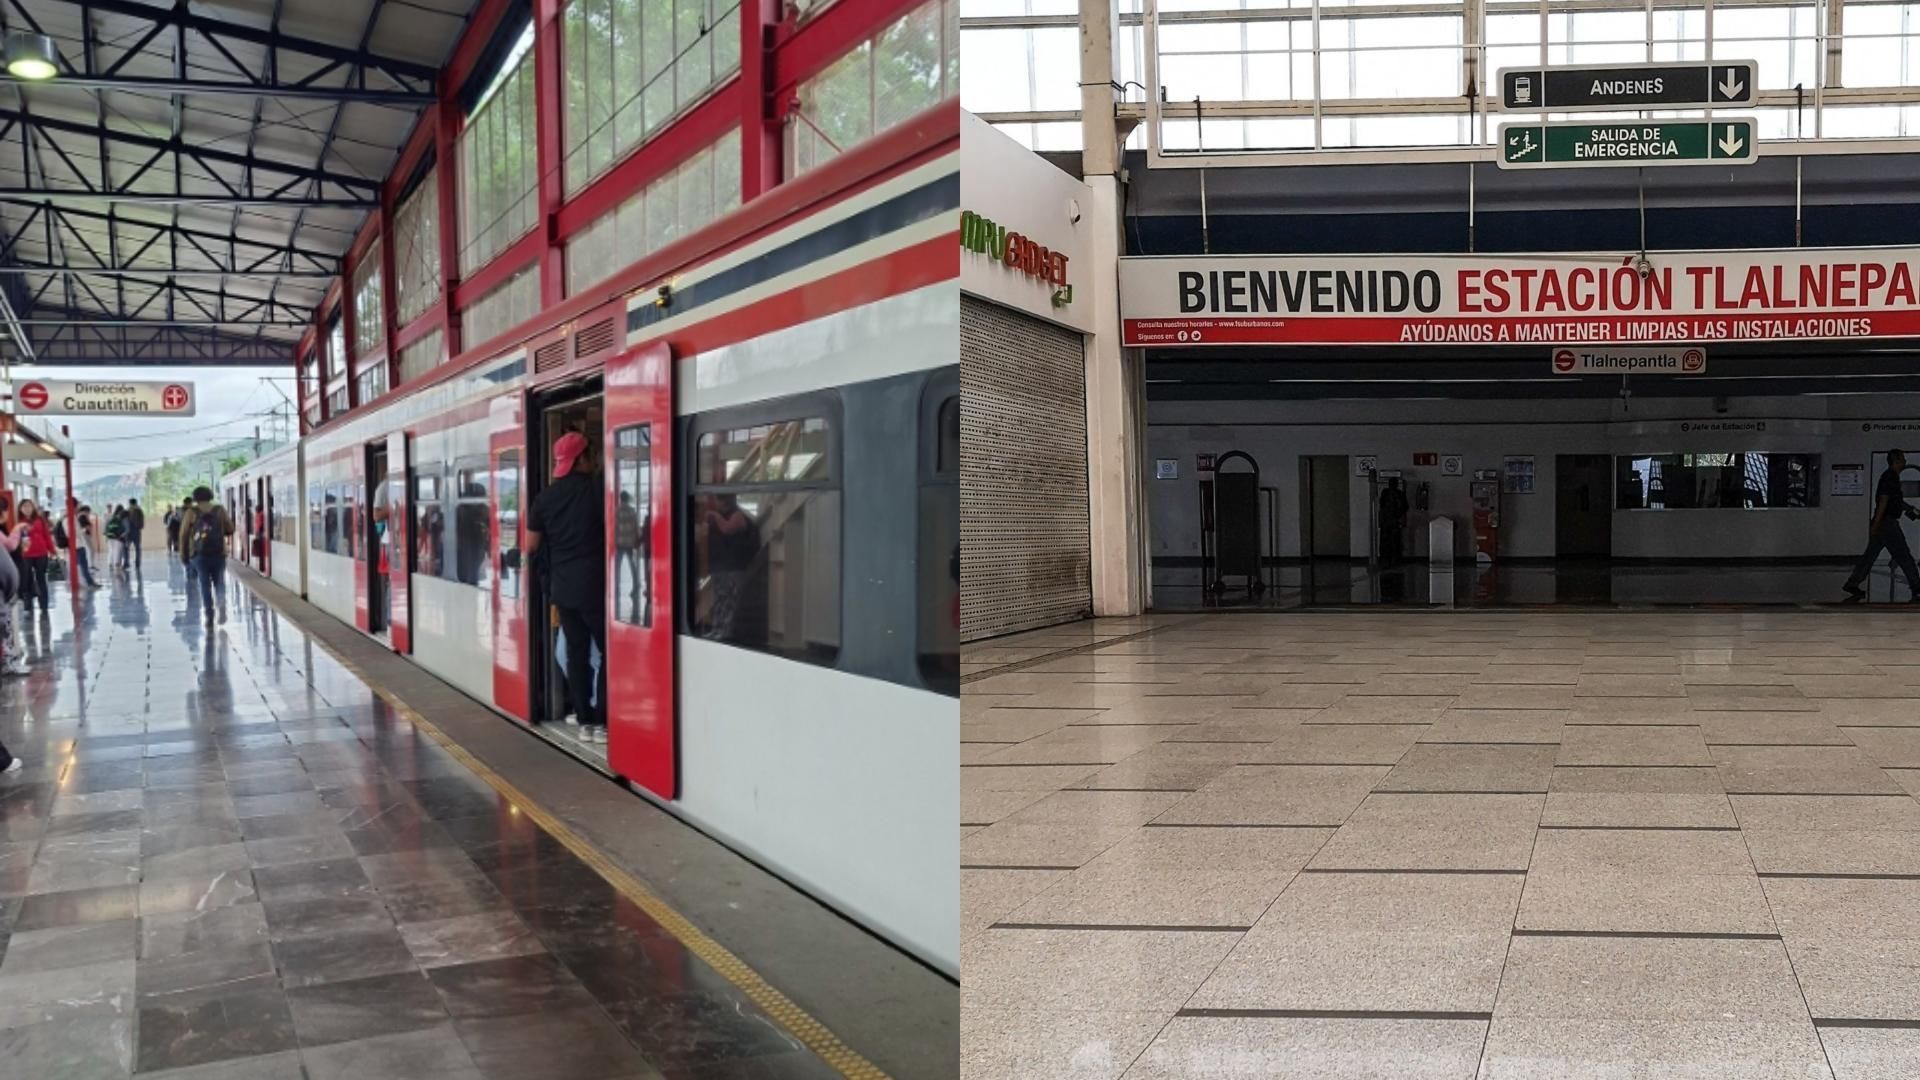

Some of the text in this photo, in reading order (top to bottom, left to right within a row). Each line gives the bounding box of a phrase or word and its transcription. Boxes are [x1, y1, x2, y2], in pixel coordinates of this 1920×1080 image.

[1589, 78, 1664, 96] ANDENES
[1591, 128, 1661, 142] SALIDA DE
[1574, 140, 1679, 158] EMERGENCIA
[1178, 256, 1920, 313] BIENVENIDO ESTACIÓN TLALNEPA
[1163, 320, 1189, 328] nuestros
[1399, 318, 1872, 342] AYÚDANOS A MANTENER LIMPIAS LAS INSTALACIONES
[1580, 354, 1677, 370] Tlalnepantla
[75, 383, 136, 394] Dirección
[63, 397, 149, 412] Cuautitlán
[1722, 422, 1755, 431] Estación
